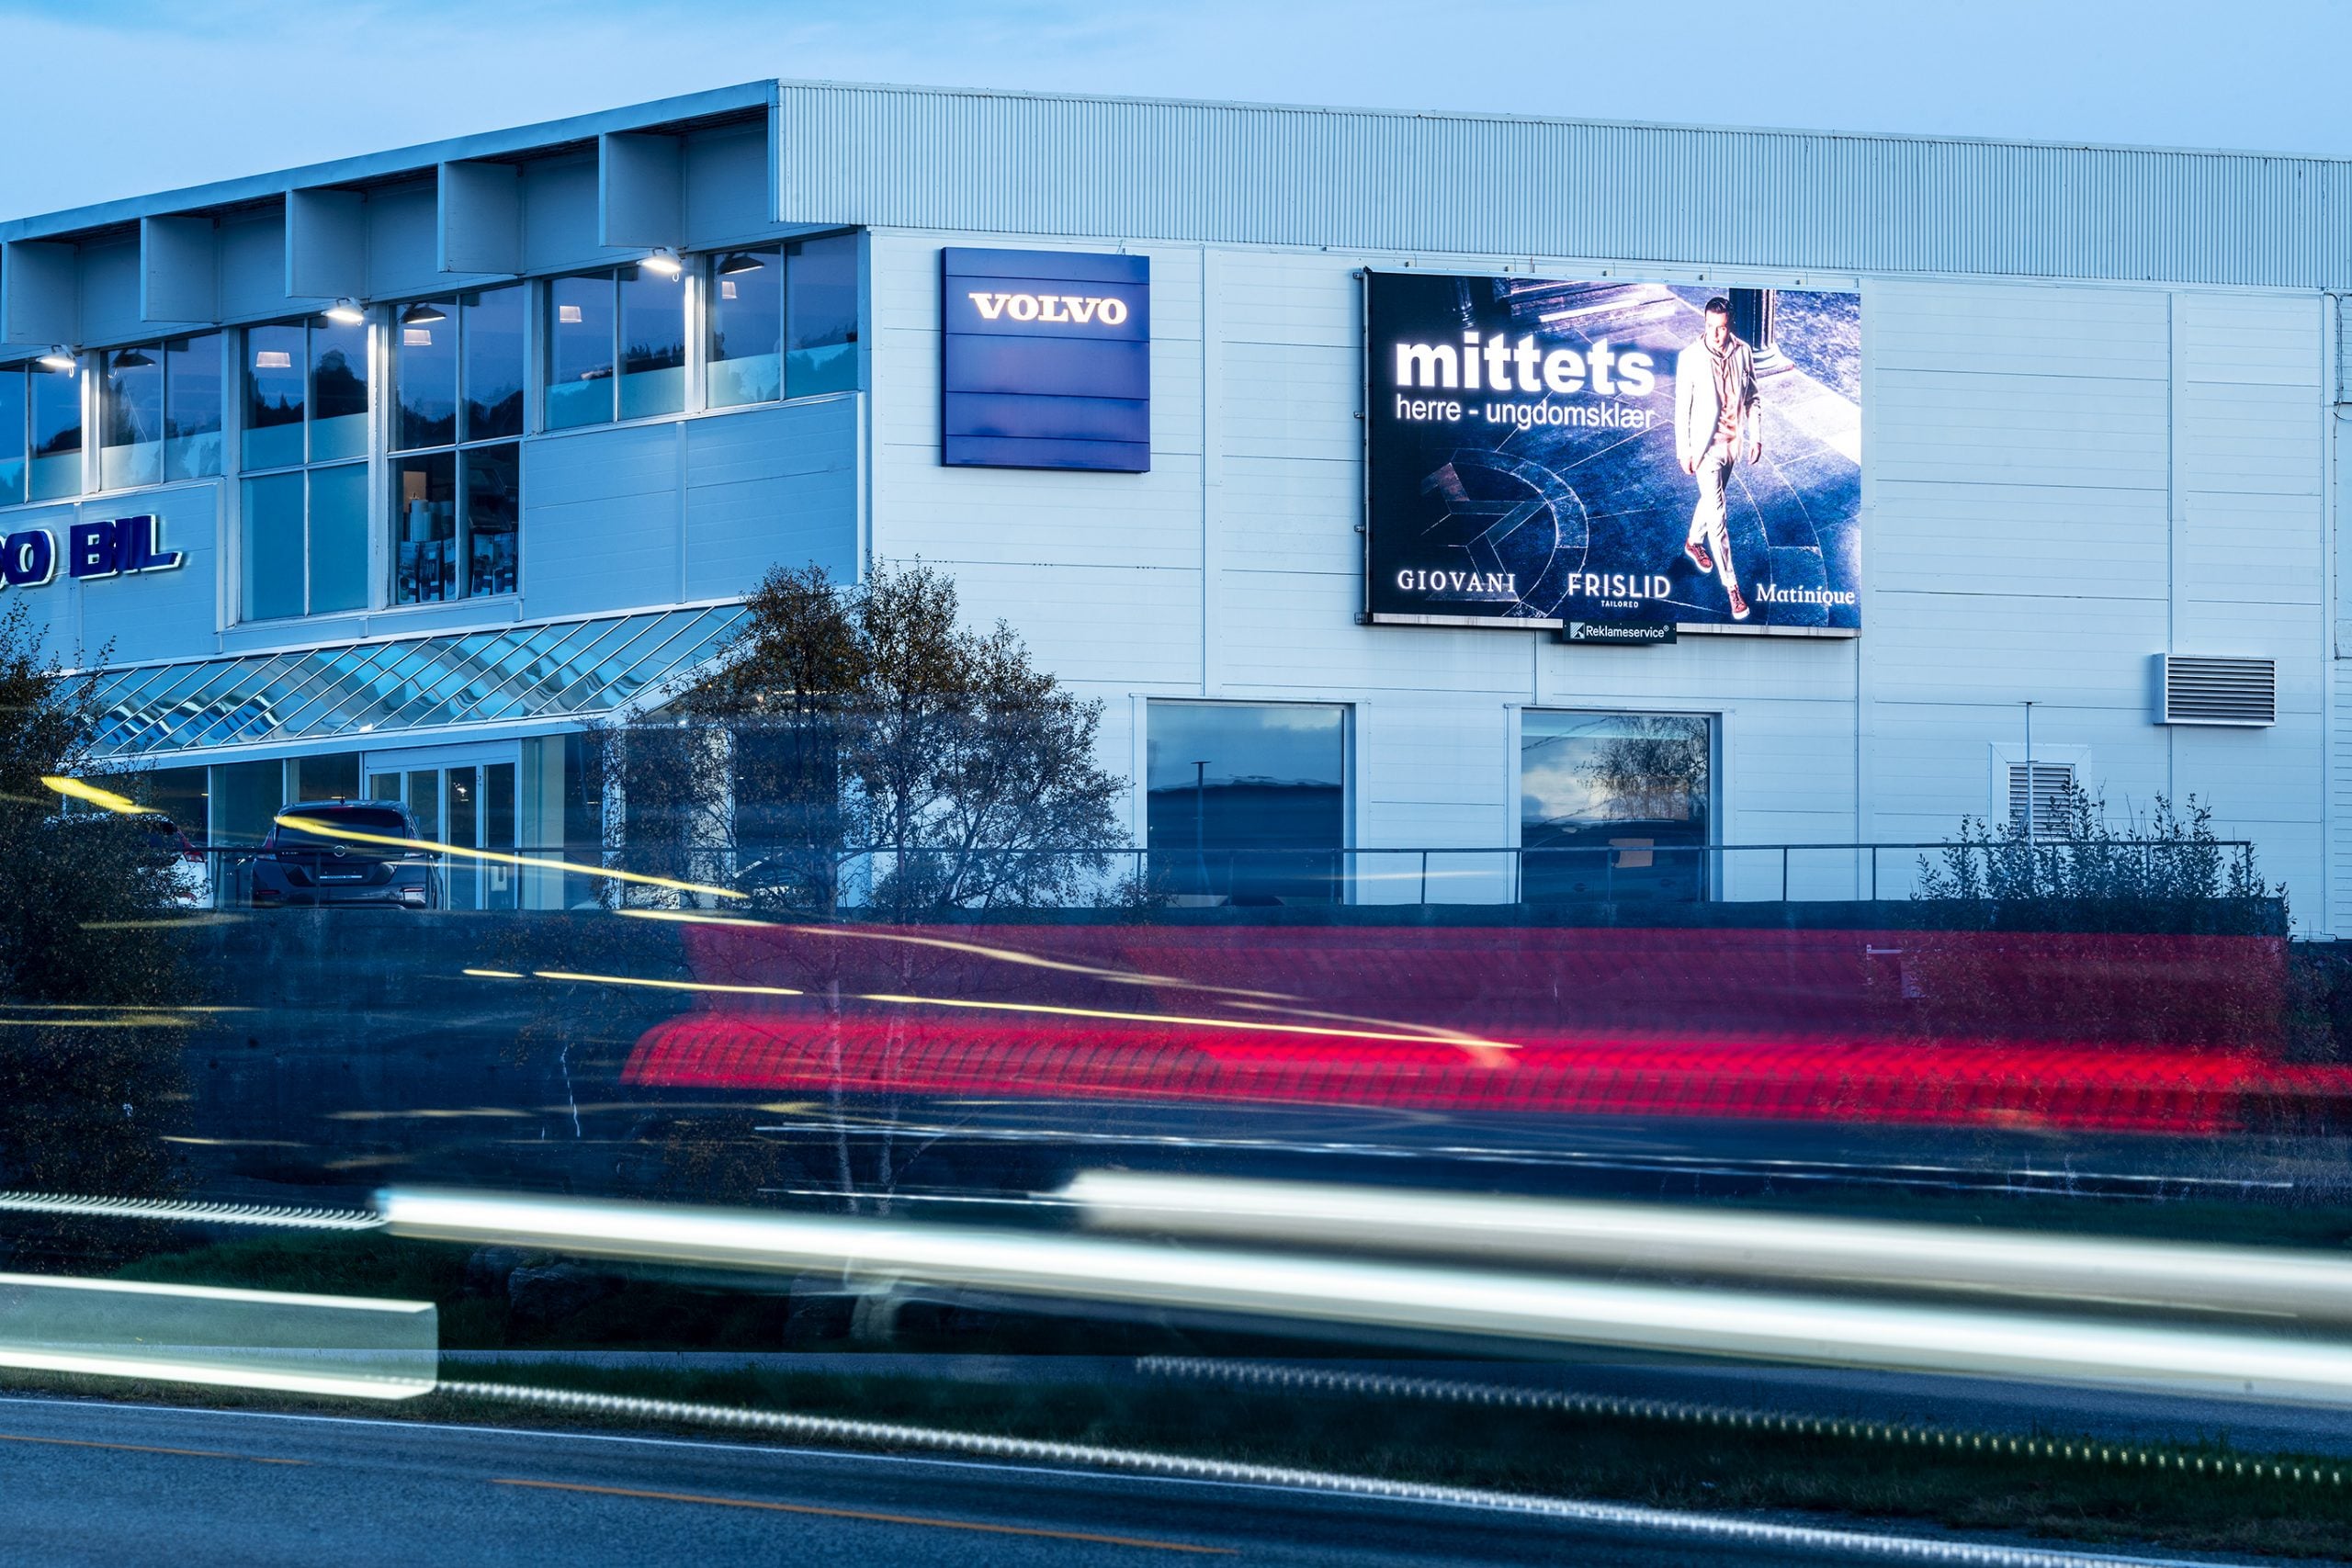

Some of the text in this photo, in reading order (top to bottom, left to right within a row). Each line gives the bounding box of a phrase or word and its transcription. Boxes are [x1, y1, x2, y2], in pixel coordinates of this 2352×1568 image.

[968, 292, 1128, 325] VOLVO
[1396, 331, 1656, 397] mittets
[1396, 393, 1461, 422] herre
[1486, 400, 1654, 430] ungdomsklær
[0, 514, 183, 588] O BIL
[1397, 570, 1516, 593] GIOVANI
[1567, 572, 1671, 600] FRISLID
[1756, 582, 1856, 606] Matinique
[1600, 599, 1639, 609] TAILORED
